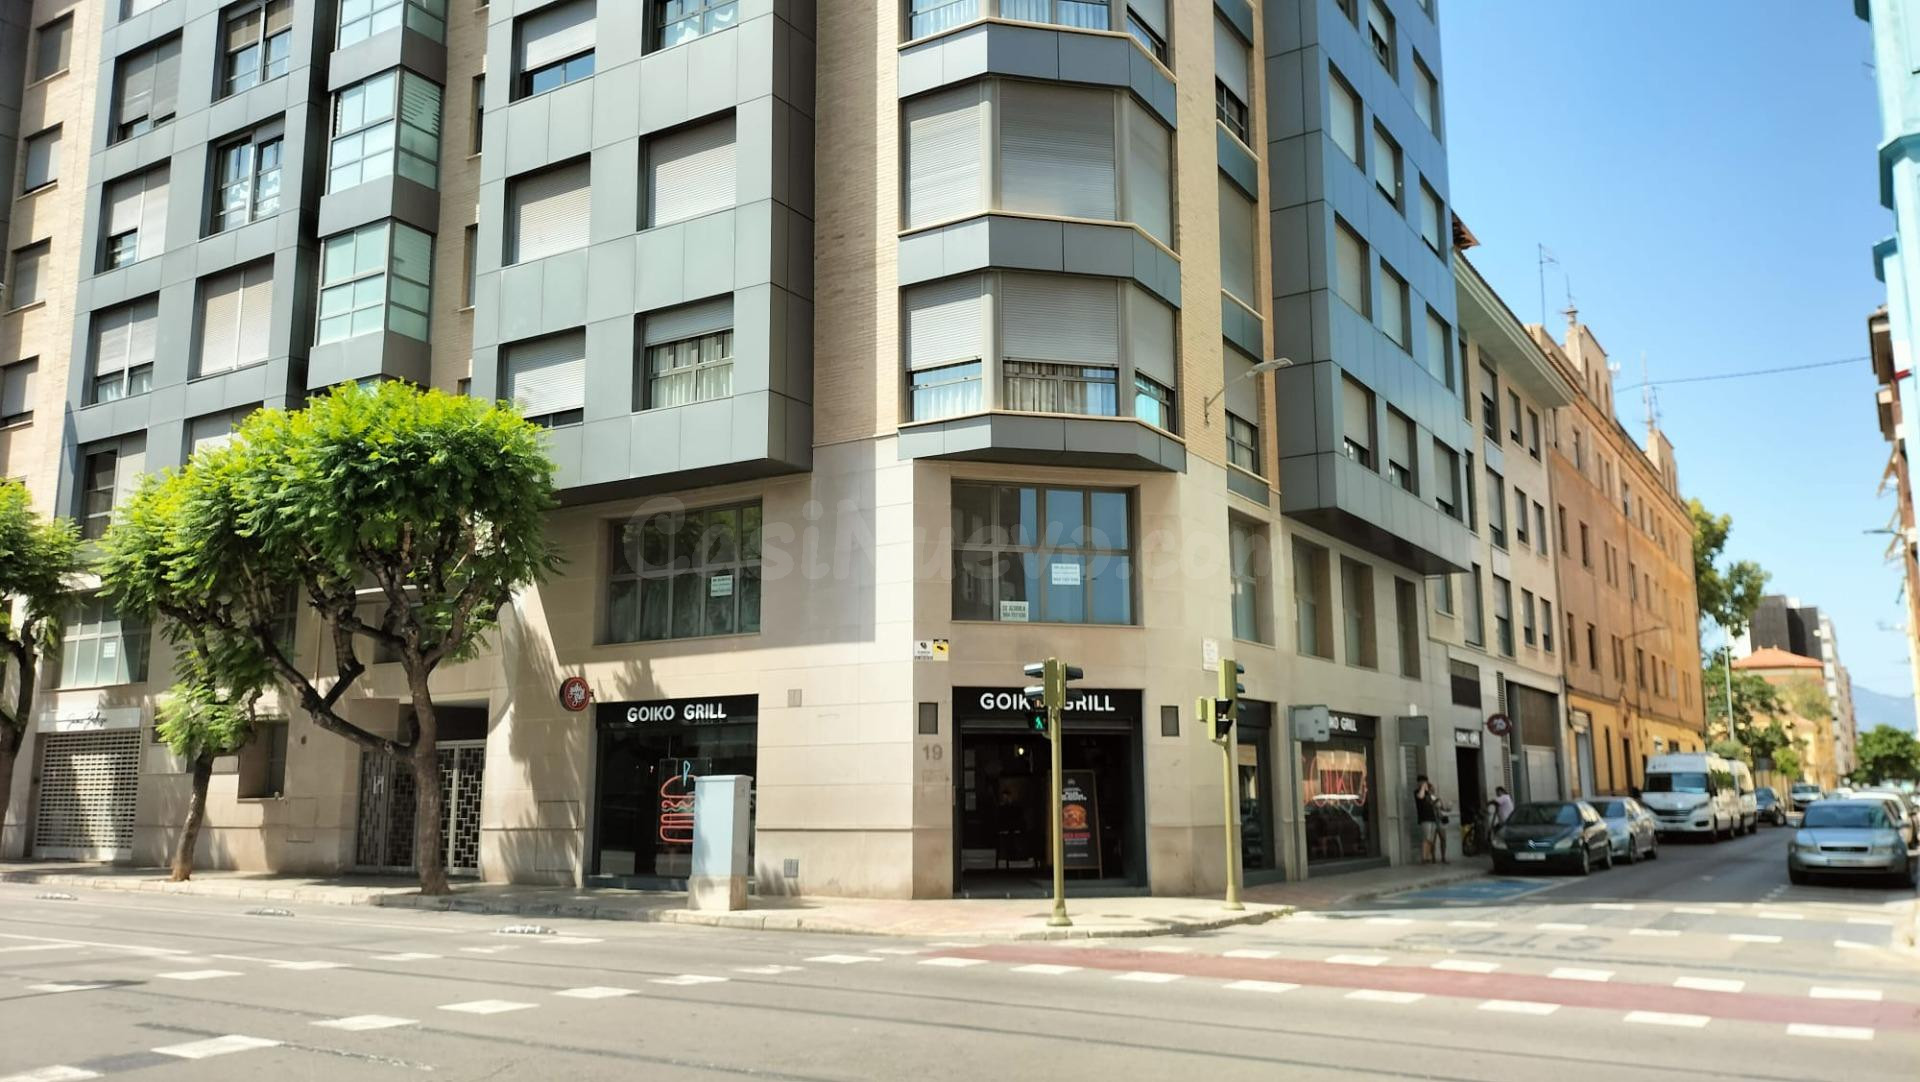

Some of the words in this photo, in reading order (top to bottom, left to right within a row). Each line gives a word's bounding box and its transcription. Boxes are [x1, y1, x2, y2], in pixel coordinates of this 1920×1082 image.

[980, 693, 1045, 711] GOIK
[627, 705, 675, 722] GOIKO
[684, 703, 727, 720] GRILL
[922, 743, 943, 761] 19
